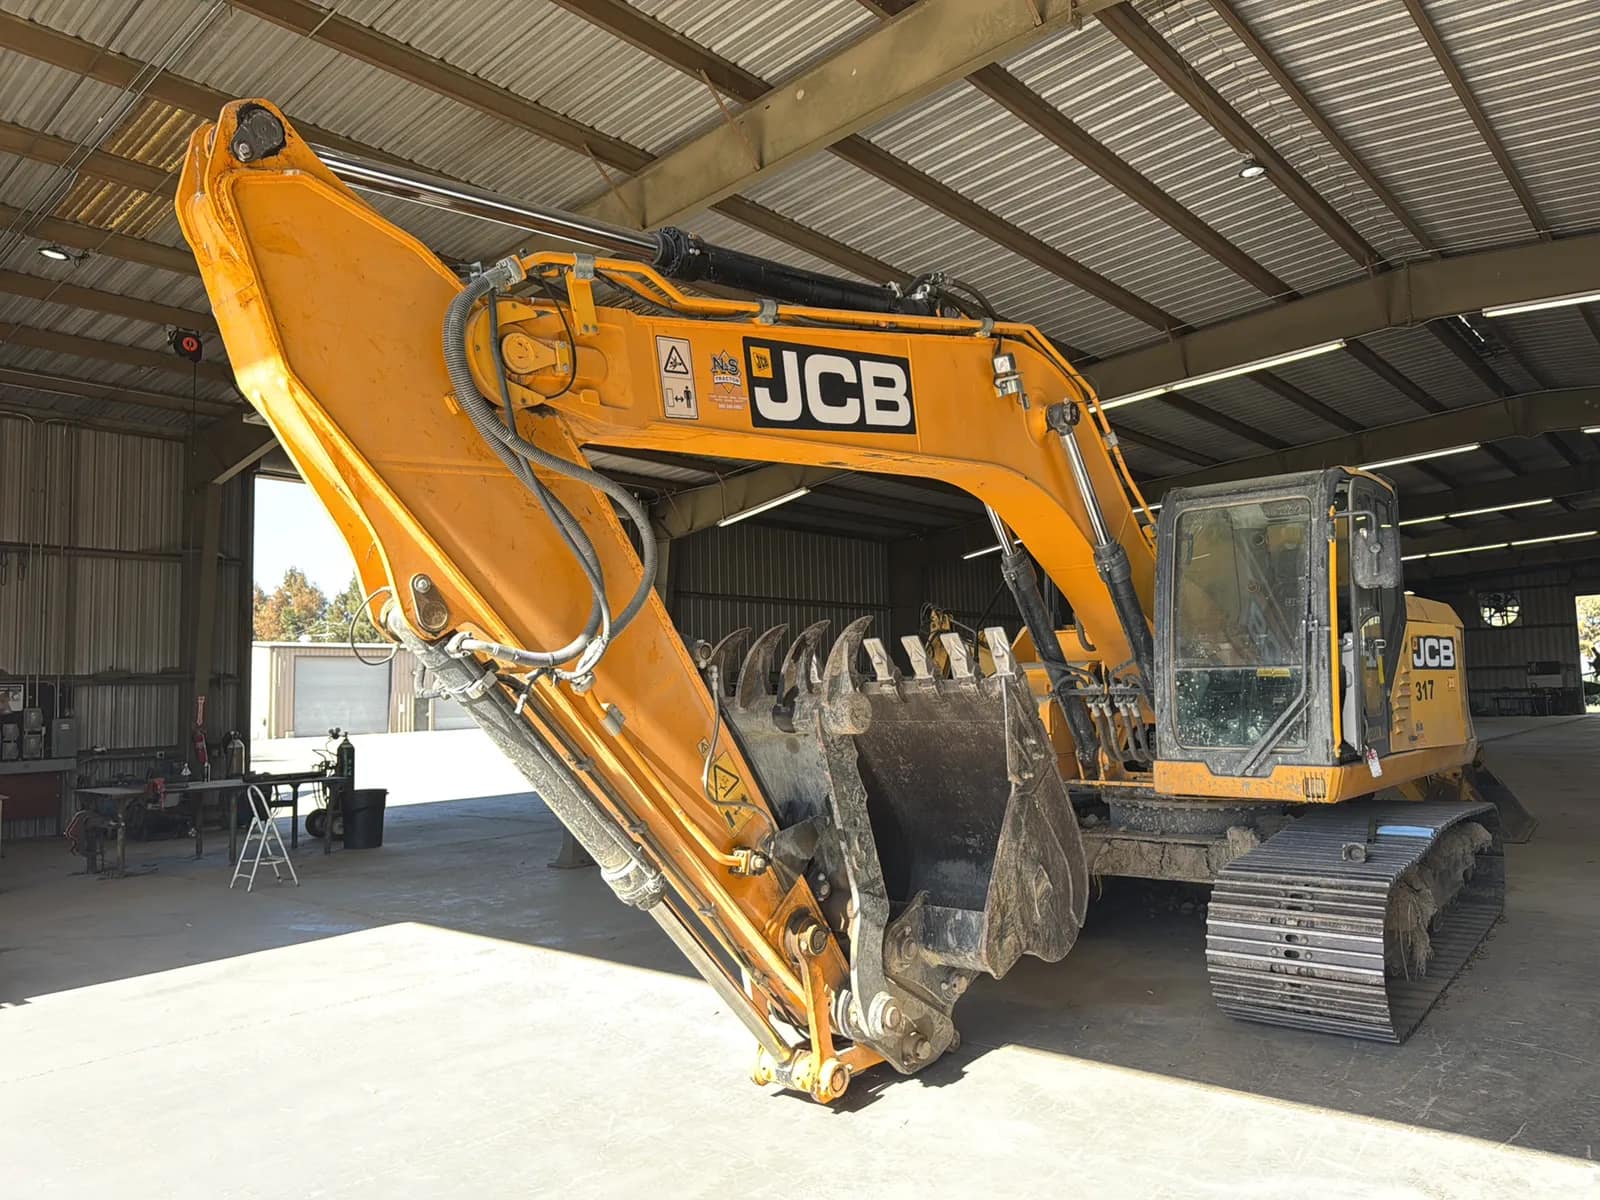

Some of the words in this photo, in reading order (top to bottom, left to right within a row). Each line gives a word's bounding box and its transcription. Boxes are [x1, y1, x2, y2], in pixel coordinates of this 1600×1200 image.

[753, 350, 912, 427] JCB
[1413, 637, 1455, 667] JCB
[1415, 680, 1434, 701] 317
